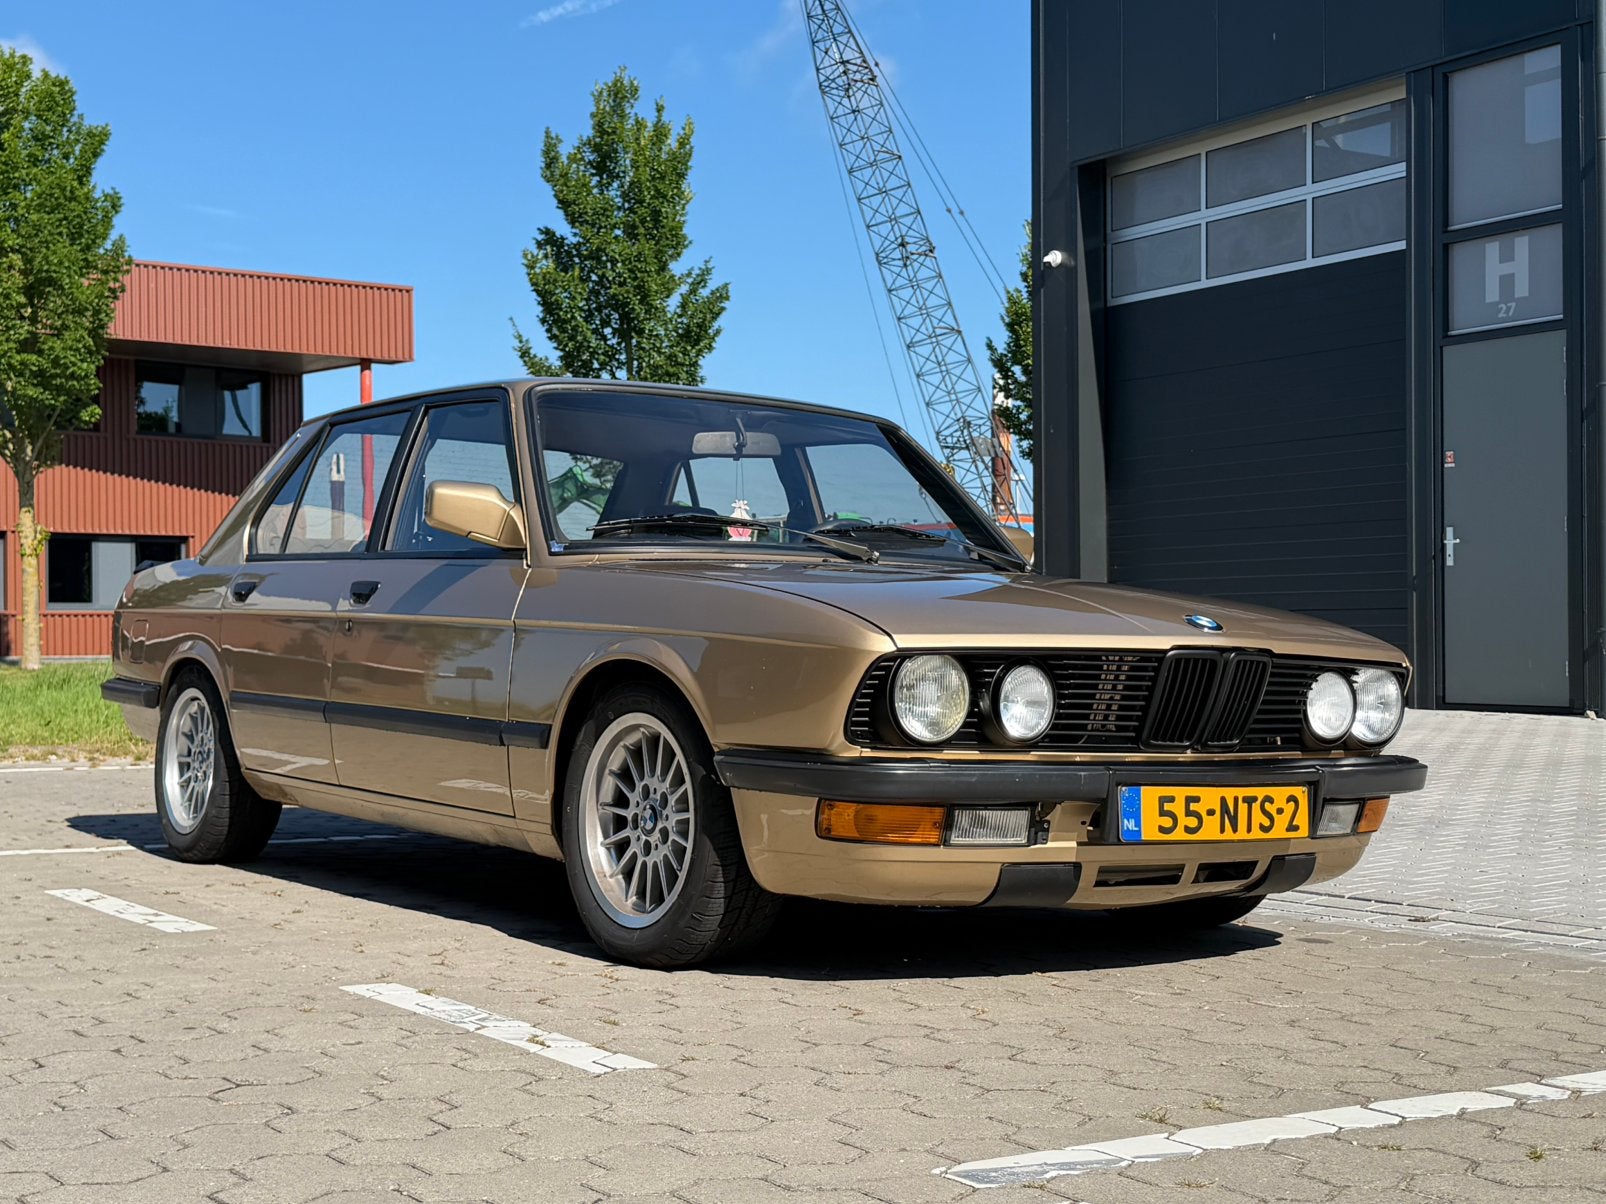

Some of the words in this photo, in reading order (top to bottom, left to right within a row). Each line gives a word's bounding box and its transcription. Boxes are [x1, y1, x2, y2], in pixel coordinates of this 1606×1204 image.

[1485, 236, 1529, 303] H
[1498, 302, 1516, 318] 27
[1123, 818, 1140, 832] NL
[1157, 794, 1301, 835] 55-NTS-2
